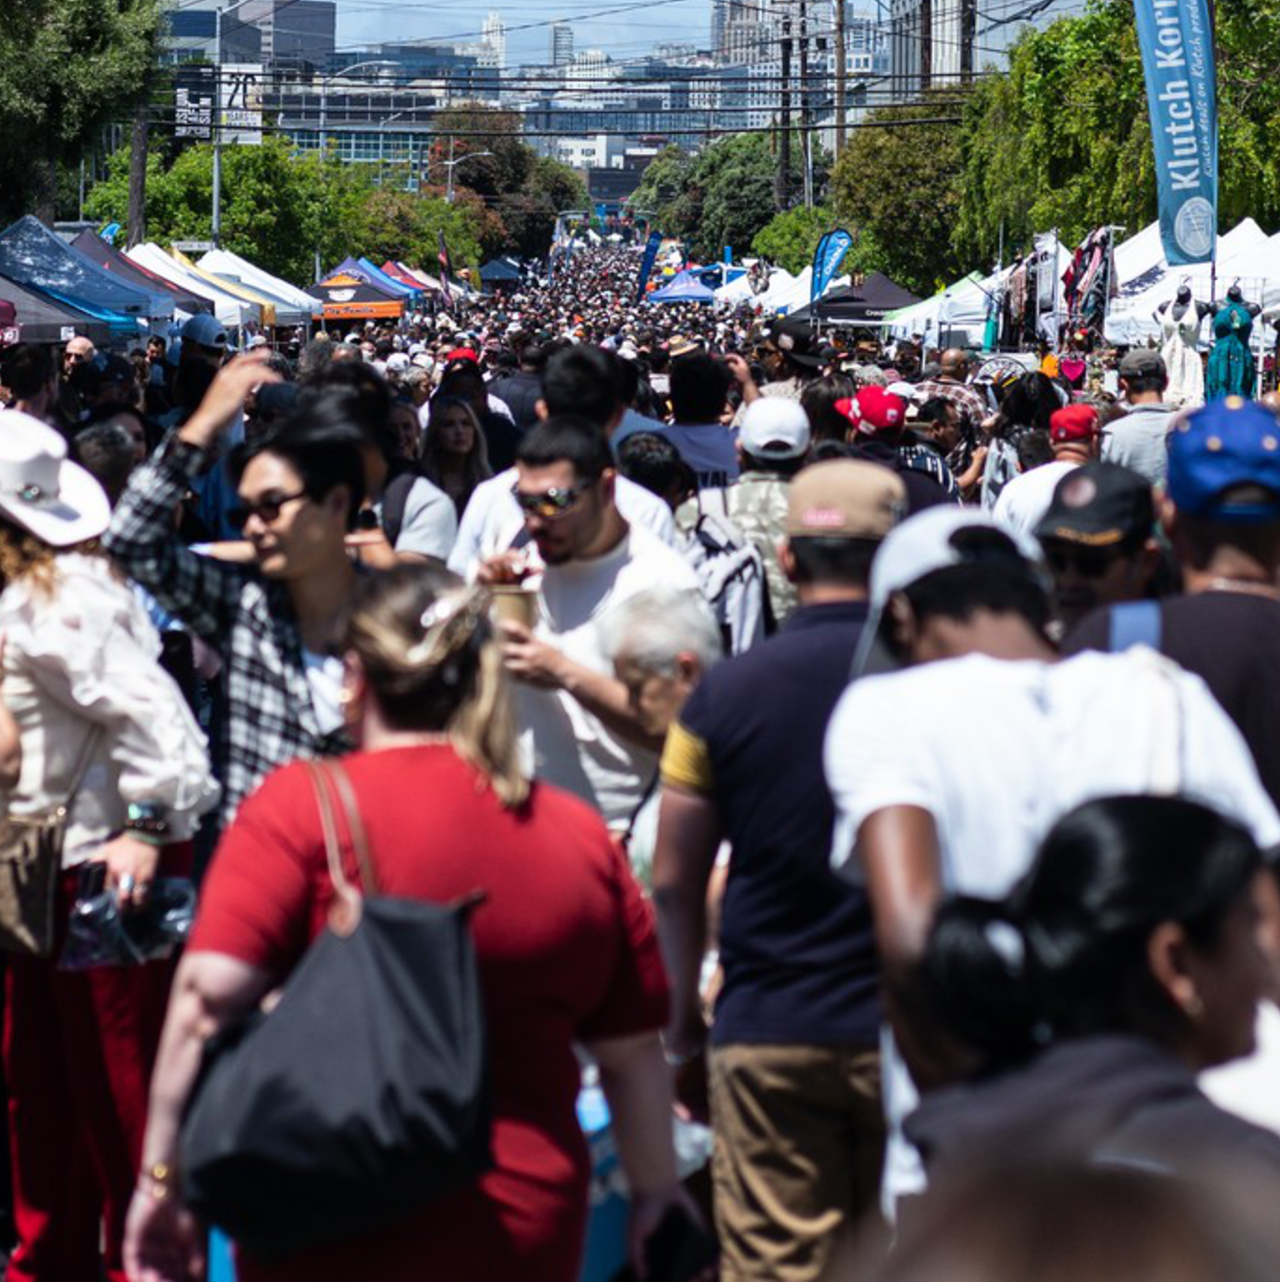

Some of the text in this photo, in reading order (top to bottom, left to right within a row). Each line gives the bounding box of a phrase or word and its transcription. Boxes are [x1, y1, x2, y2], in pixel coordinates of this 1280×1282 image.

[1189, 36, 1206, 78] Klutch
[1197, 82, 1206, 98] on
[1158, 79, 1200, 191] Klutch
